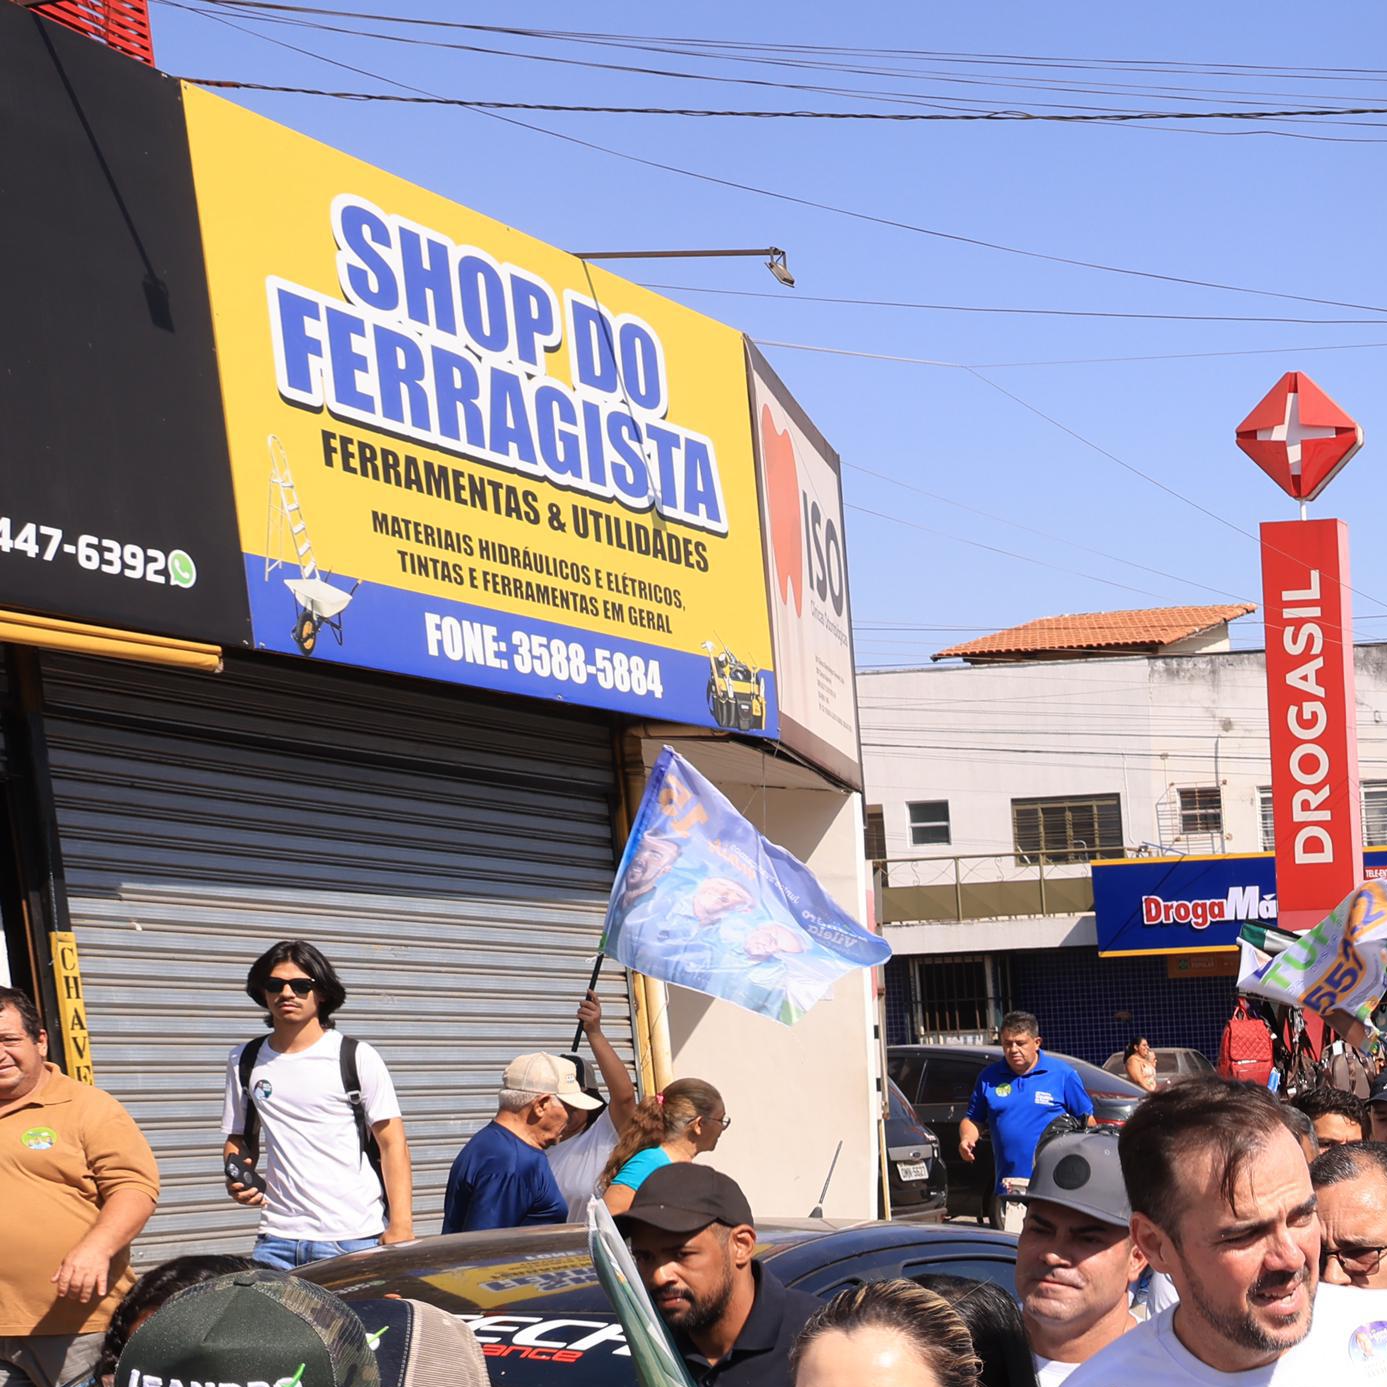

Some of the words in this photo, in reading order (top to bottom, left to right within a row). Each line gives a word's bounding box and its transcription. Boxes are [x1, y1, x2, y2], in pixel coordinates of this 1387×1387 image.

[336, 200, 558, 372] SHOP
[569, 297, 664, 412] DO
[274, 285, 723, 526] FERRAGISTA
[320, 428, 541, 526] FERRAMENTAS
[547, 502, 567, 533] &
[572, 503, 710, 574] UTILIDADES
[371, 509, 475, 557] MATERIAIS
[478, 538, 592, 587] HIDRÁULICOS
[594, 568, 603, 590] E
[606, 570, 686, 612] ELÉTRICOS,
[802, 488, 844, 618] ISO
[397, 549, 464, 587] TINTAS
[469, 567, 478, 590] E
[482, 570, 600, 618] FERRAMENTAS
[603, 598, 625, 624] EM
[627, 605, 673, 634] GERAL
[424, 611, 509, 671] FONE:
[511, 629, 664, 699] 3588-5884
[1280, 568, 1333, 865] DROGASIL
